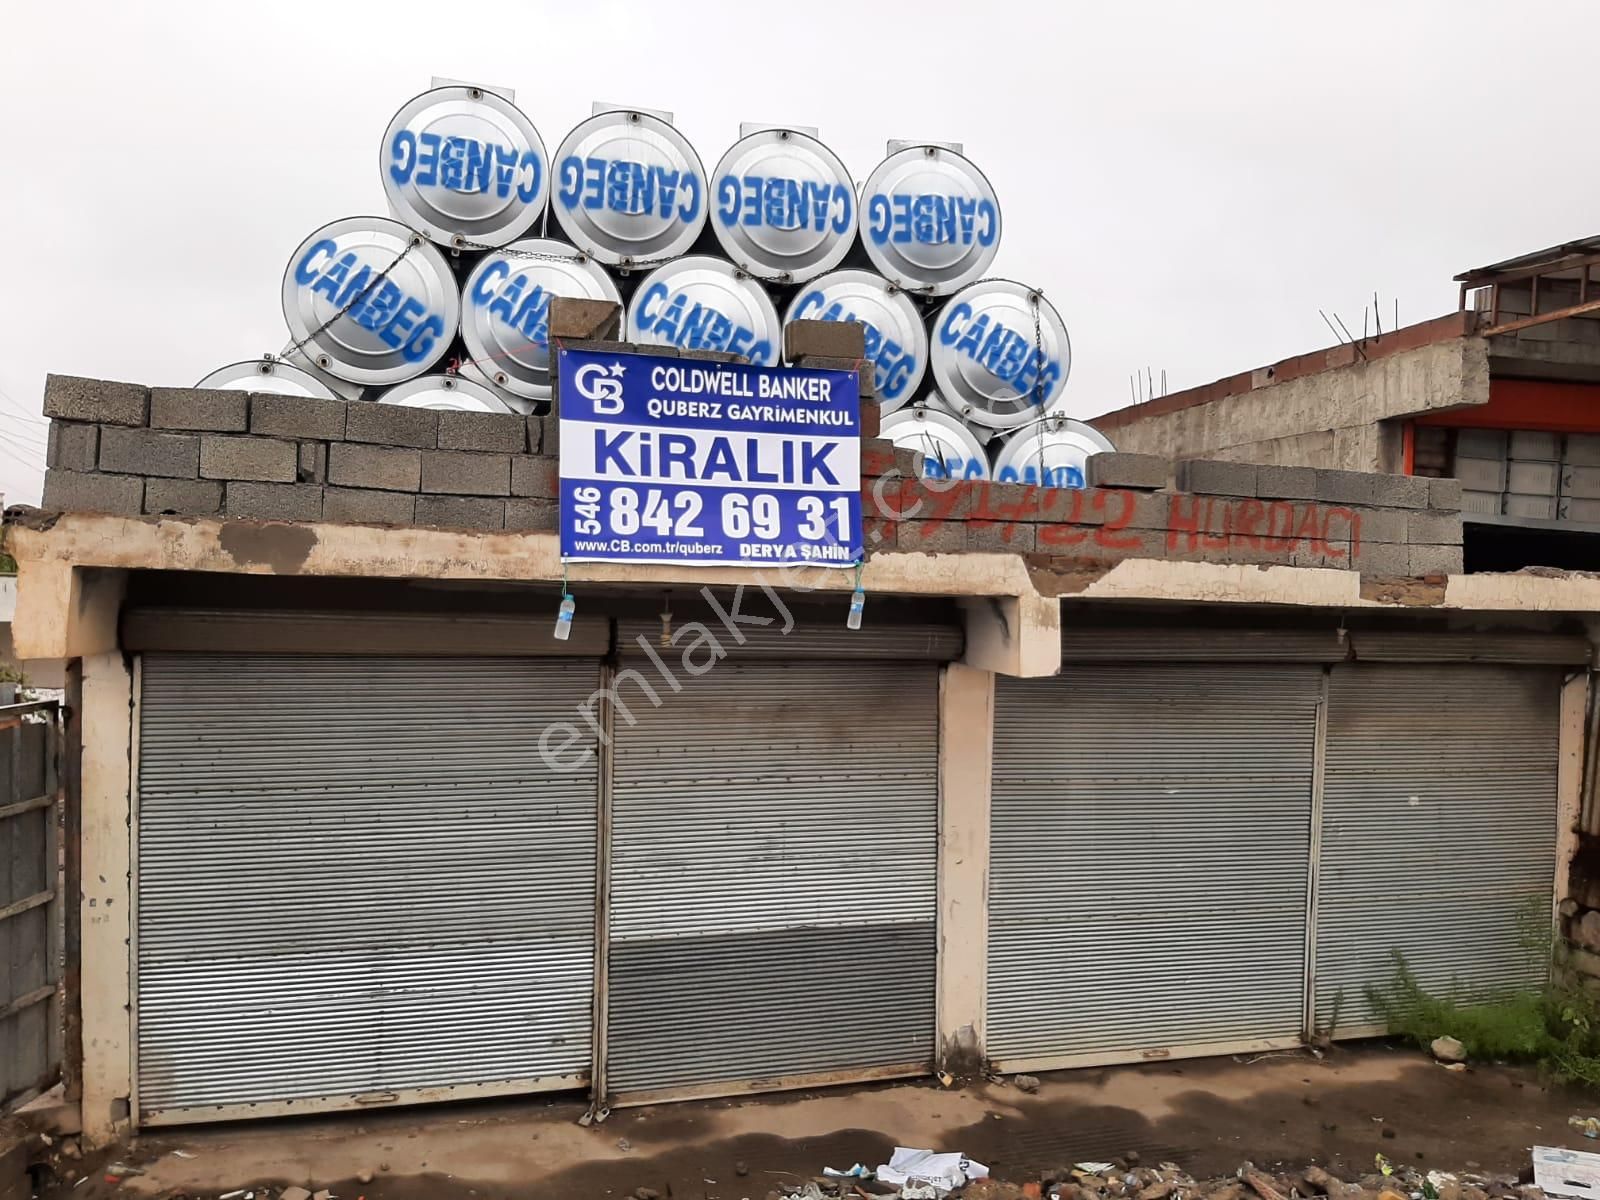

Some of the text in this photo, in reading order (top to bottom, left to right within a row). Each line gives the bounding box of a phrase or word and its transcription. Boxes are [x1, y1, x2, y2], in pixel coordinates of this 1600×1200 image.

[390, 129, 541, 204] CANBEG
[559, 155, 701, 224] CANBEG
[718, 174, 852, 235] CANBEG
[868, 193, 997, 247] CANBEG
[294, 238, 445, 364] CANBEG
[939, 302, 1062, 406] CANBEG
[651, 366, 832, 402] COLDWELL BANKER
[647, 398, 855, 426] QUBERZ GAYRİMENKUL
[573, 487, 602, 536] 546
[609, 487, 851, 542] 842 69 31
[574, 540, 851, 562] www.CB.com.tr/quberz DERYA ŞAHİN
